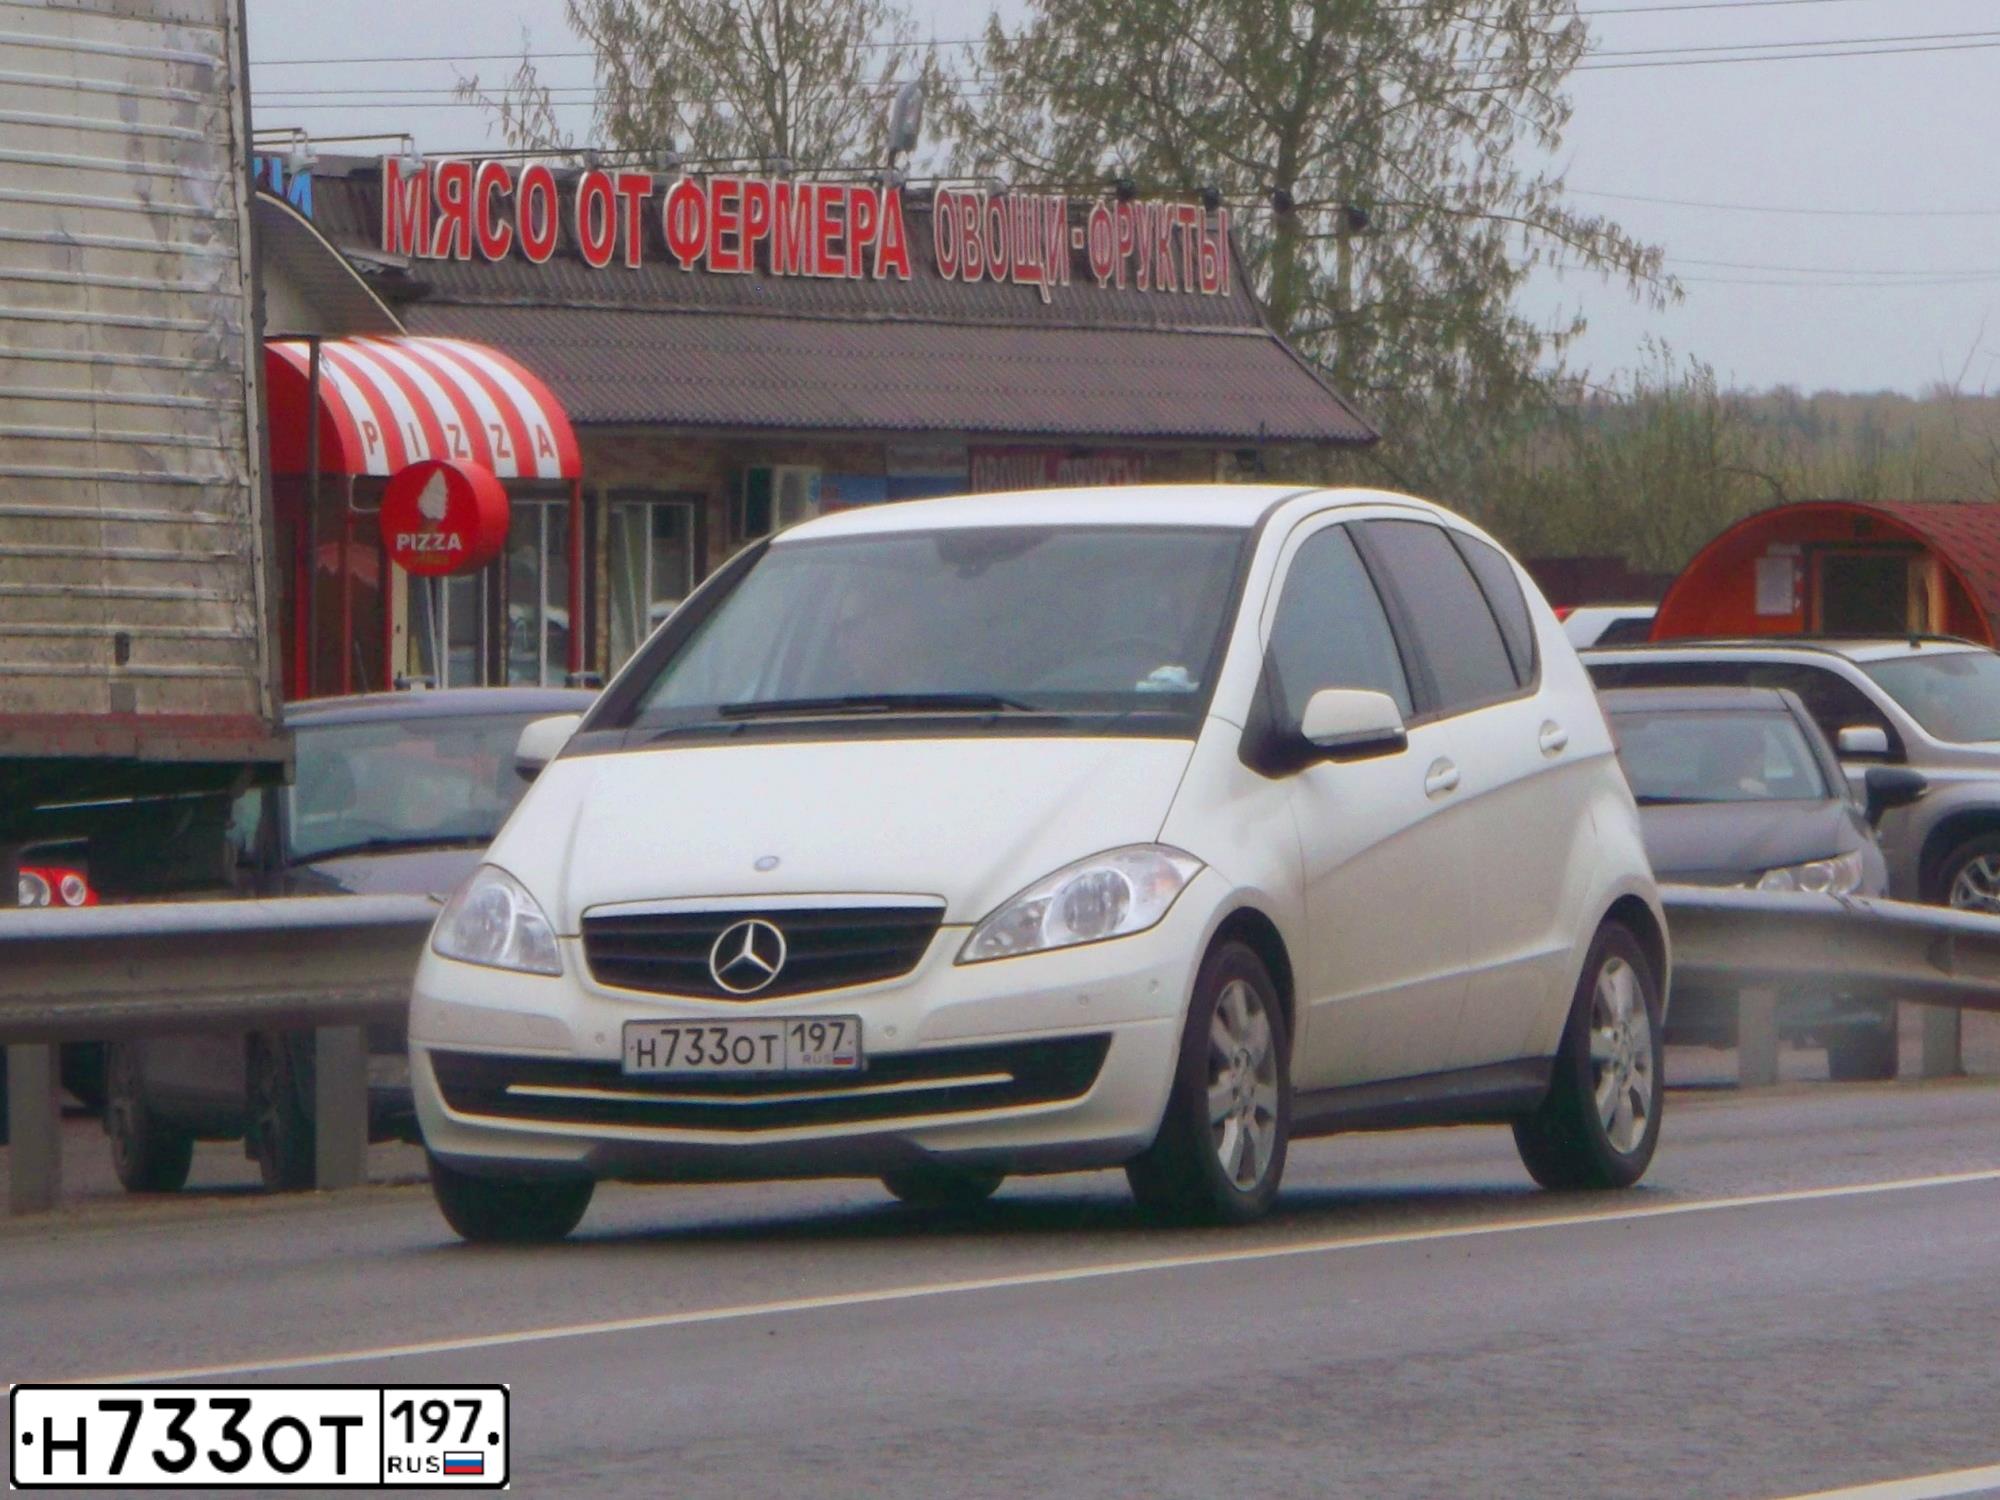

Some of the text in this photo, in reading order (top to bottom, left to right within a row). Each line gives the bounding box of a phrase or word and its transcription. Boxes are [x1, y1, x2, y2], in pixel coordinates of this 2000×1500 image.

[382, 155, 559, 263] МЯСО
[574, 170, 653, 269] ОТ
[664, 175, 911, 281] ФЕРМЕРА
[361, 420, 555, 459] PIZZA
[396, 533, 462, 551] PIZZA
[637, 1022, 845, 1067] Н733ОТ 197
